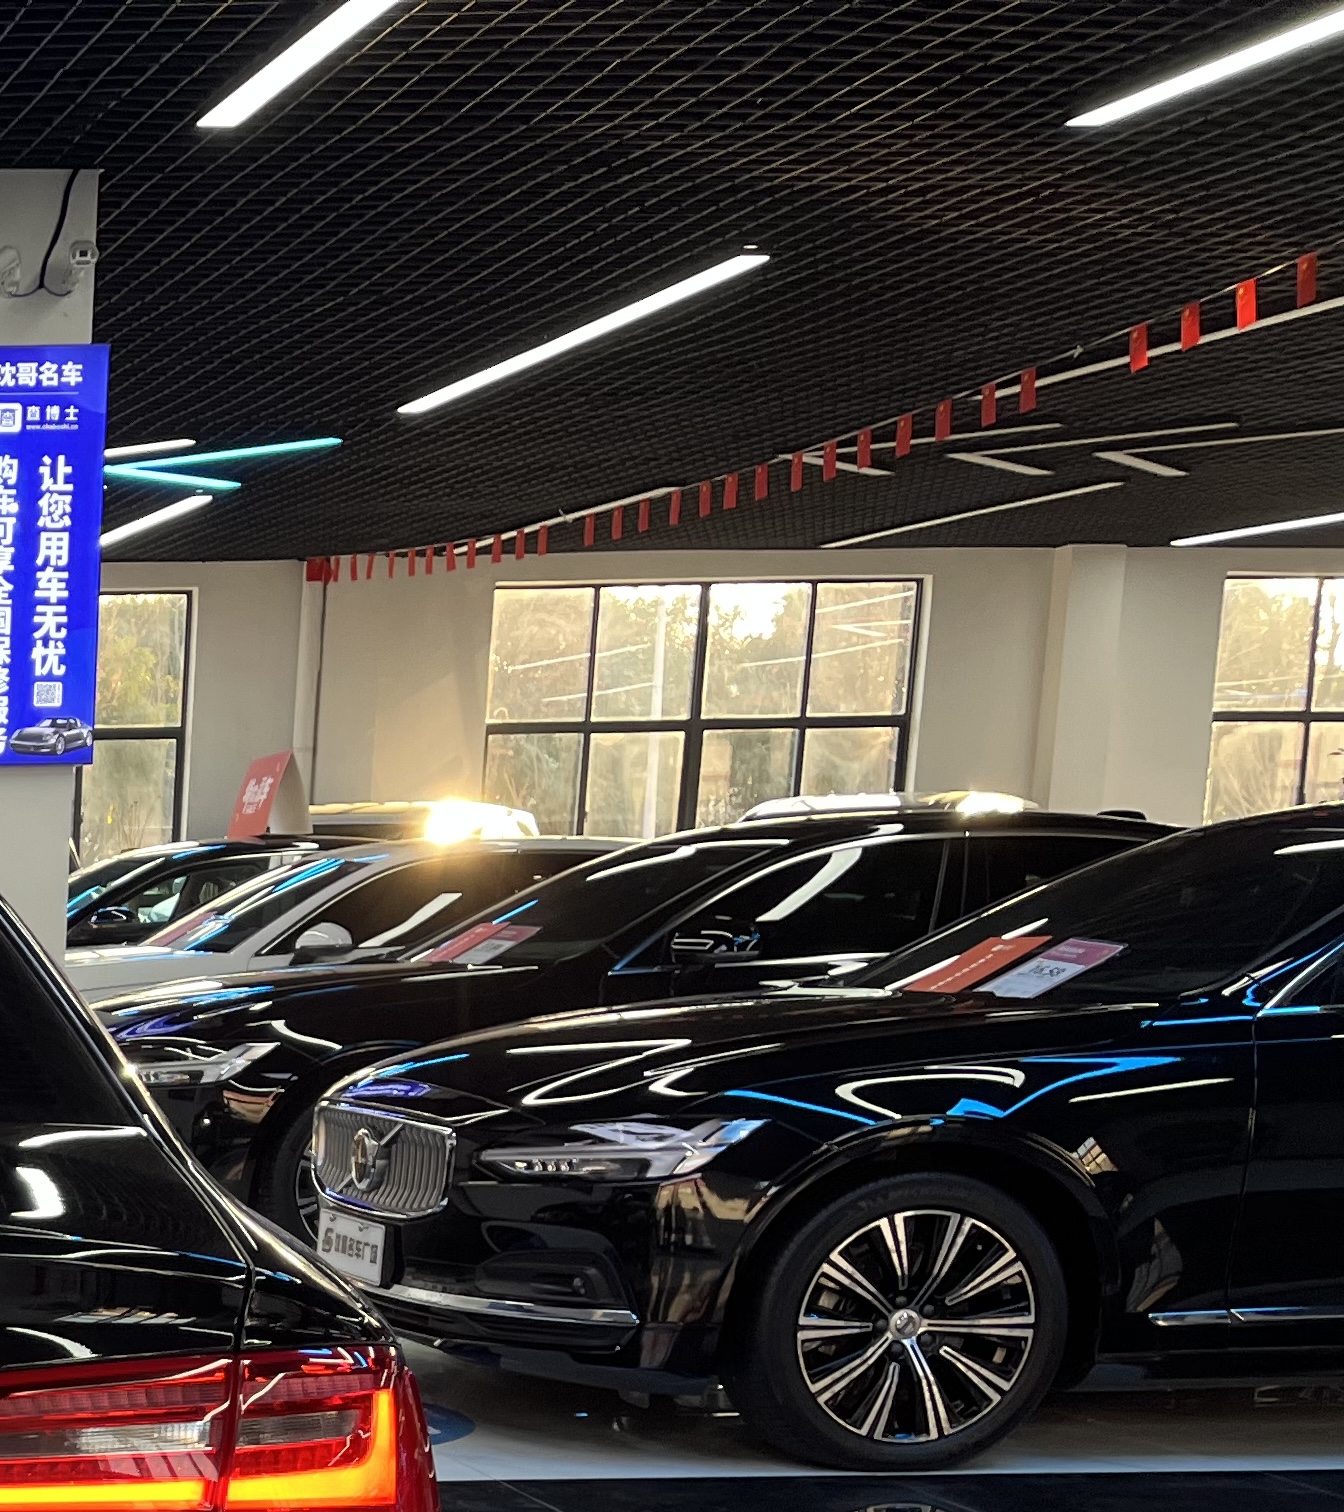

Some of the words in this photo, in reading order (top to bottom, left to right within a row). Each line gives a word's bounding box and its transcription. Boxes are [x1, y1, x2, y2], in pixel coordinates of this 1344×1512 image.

[31, 454, 75, 677] 让您用车无忧
